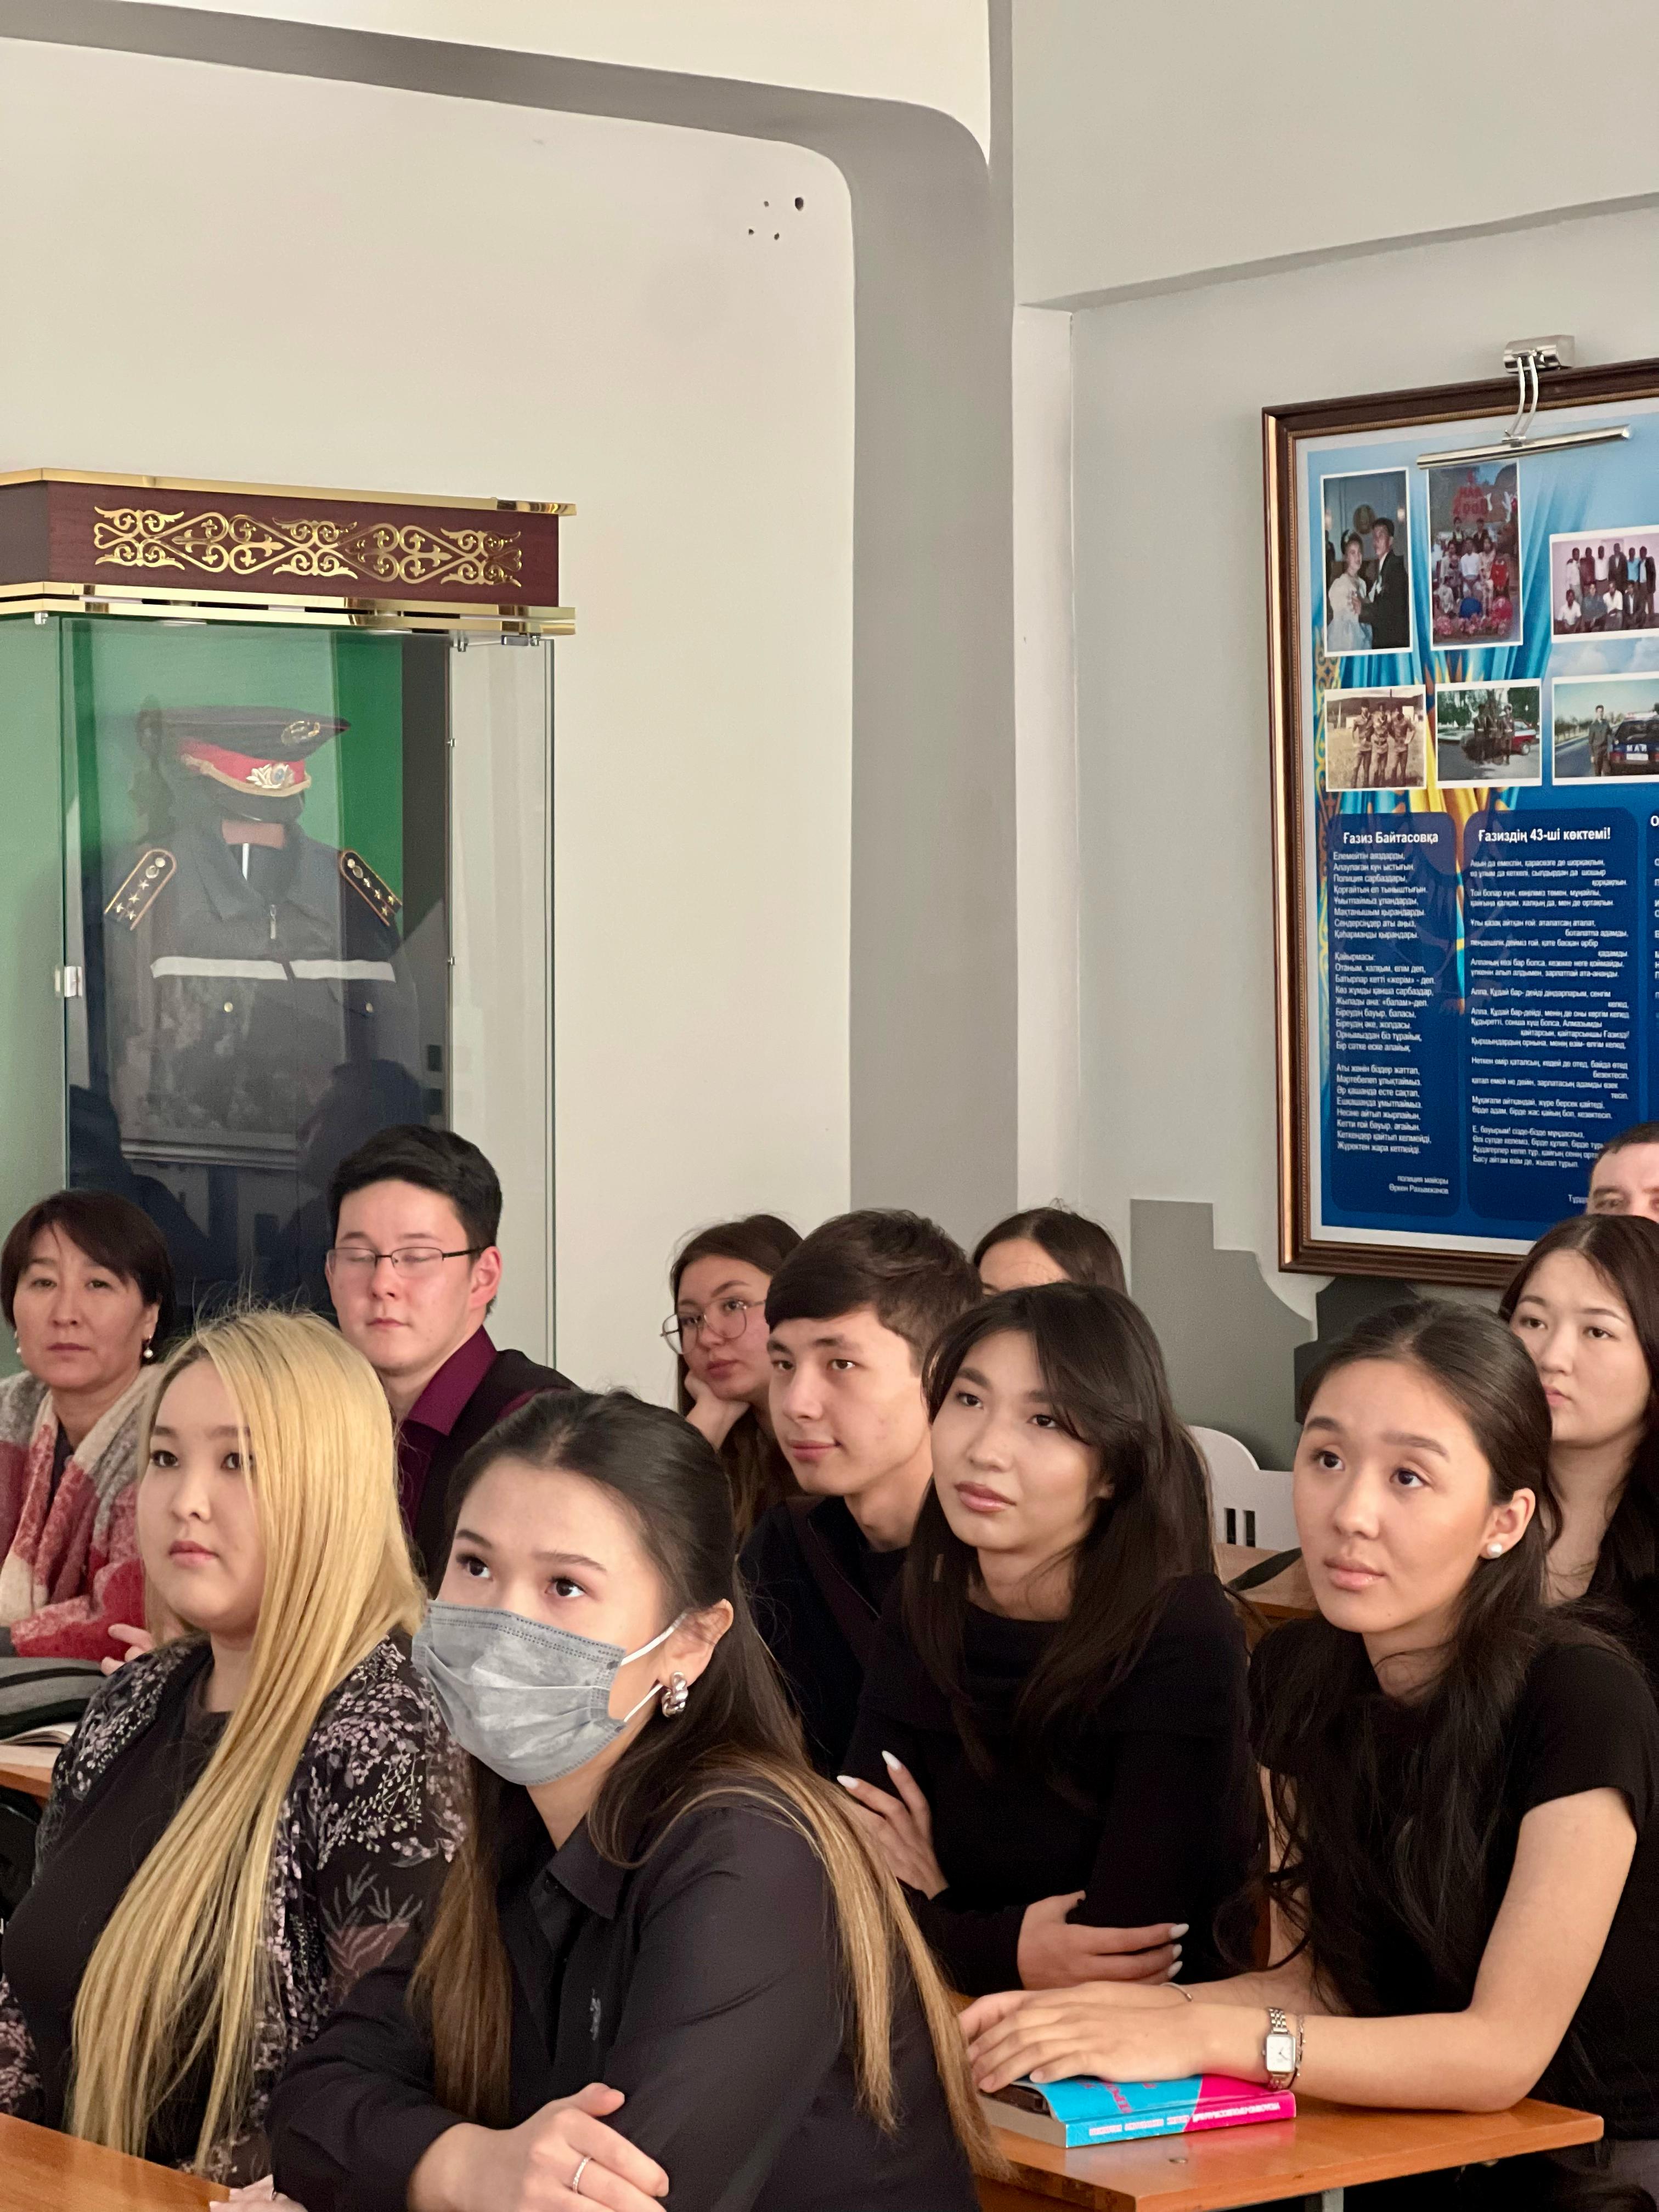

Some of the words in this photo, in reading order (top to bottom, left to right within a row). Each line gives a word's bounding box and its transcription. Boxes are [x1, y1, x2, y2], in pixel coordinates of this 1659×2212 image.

[1344, 832, 1373, 844] Ғазиз
[1376, 832, 1438, 844] Байтасовқа
[1479, 830, 1528, 843] Ғазиздің
[1531, 828, 1560, 840] 43-ші
[1564, 827, 1611, 840] көктемі!
